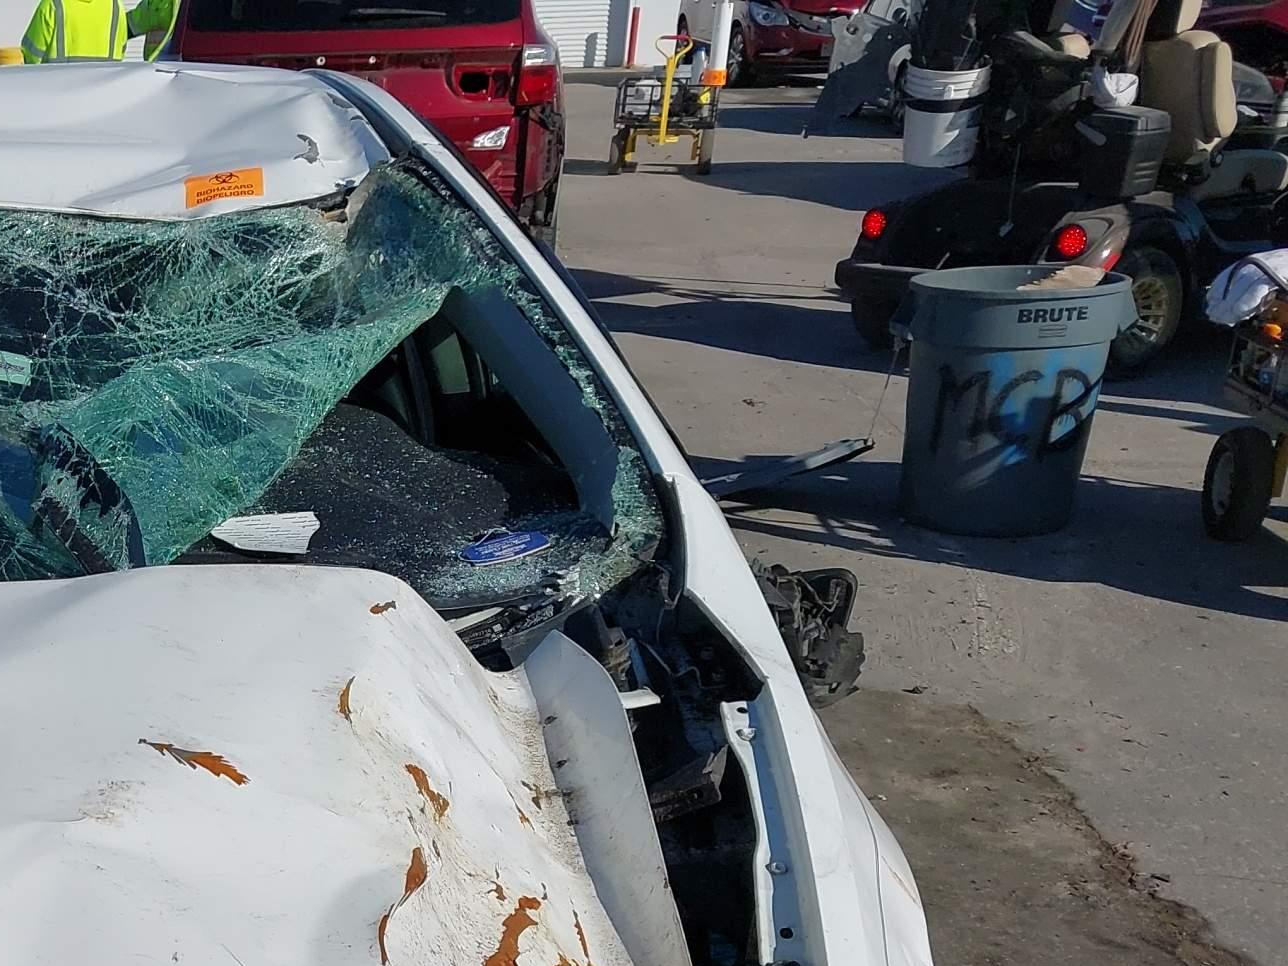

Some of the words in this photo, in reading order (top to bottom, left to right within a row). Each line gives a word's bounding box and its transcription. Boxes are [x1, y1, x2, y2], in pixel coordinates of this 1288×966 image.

[196, 183, 254, 197] BIOHAZARD
[196, 189, 255, 204] BIOPELIGRO
[1017, 306, 1089, 324] BRUTE
[929, 364, 1093, 464] MCB
